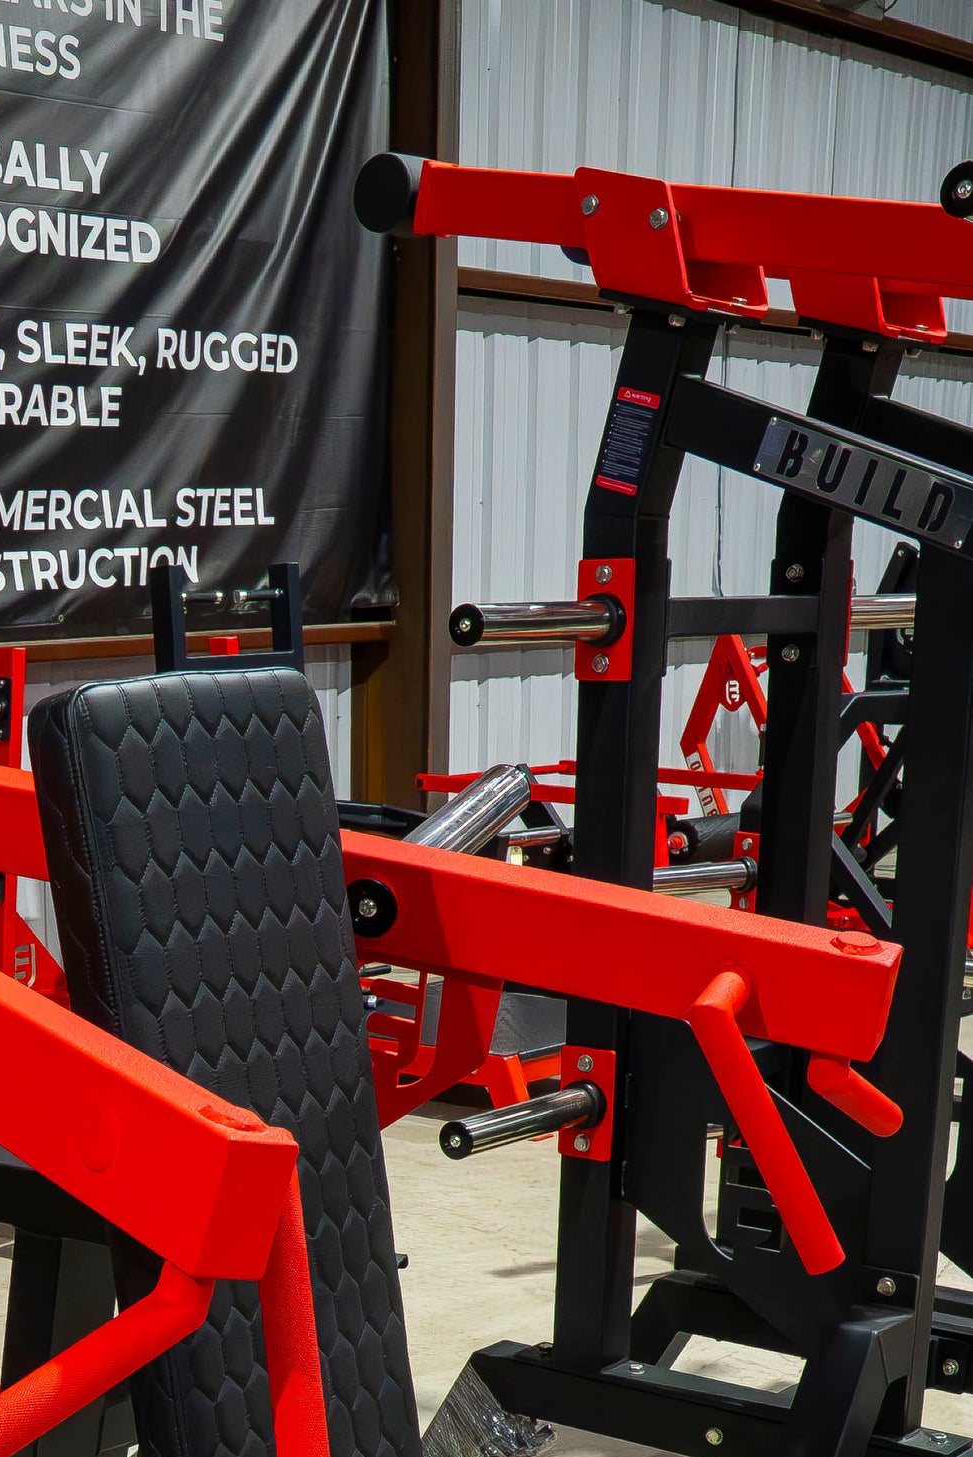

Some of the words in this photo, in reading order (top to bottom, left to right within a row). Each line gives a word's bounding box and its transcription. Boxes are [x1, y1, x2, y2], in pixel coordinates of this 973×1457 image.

[18, 321, 145, 376] SLEEK,
[157, 329, 298, 374] RUGGED
[176, 487, 276, 527] STEEL
[776, 428, 955, 533] BUILD
